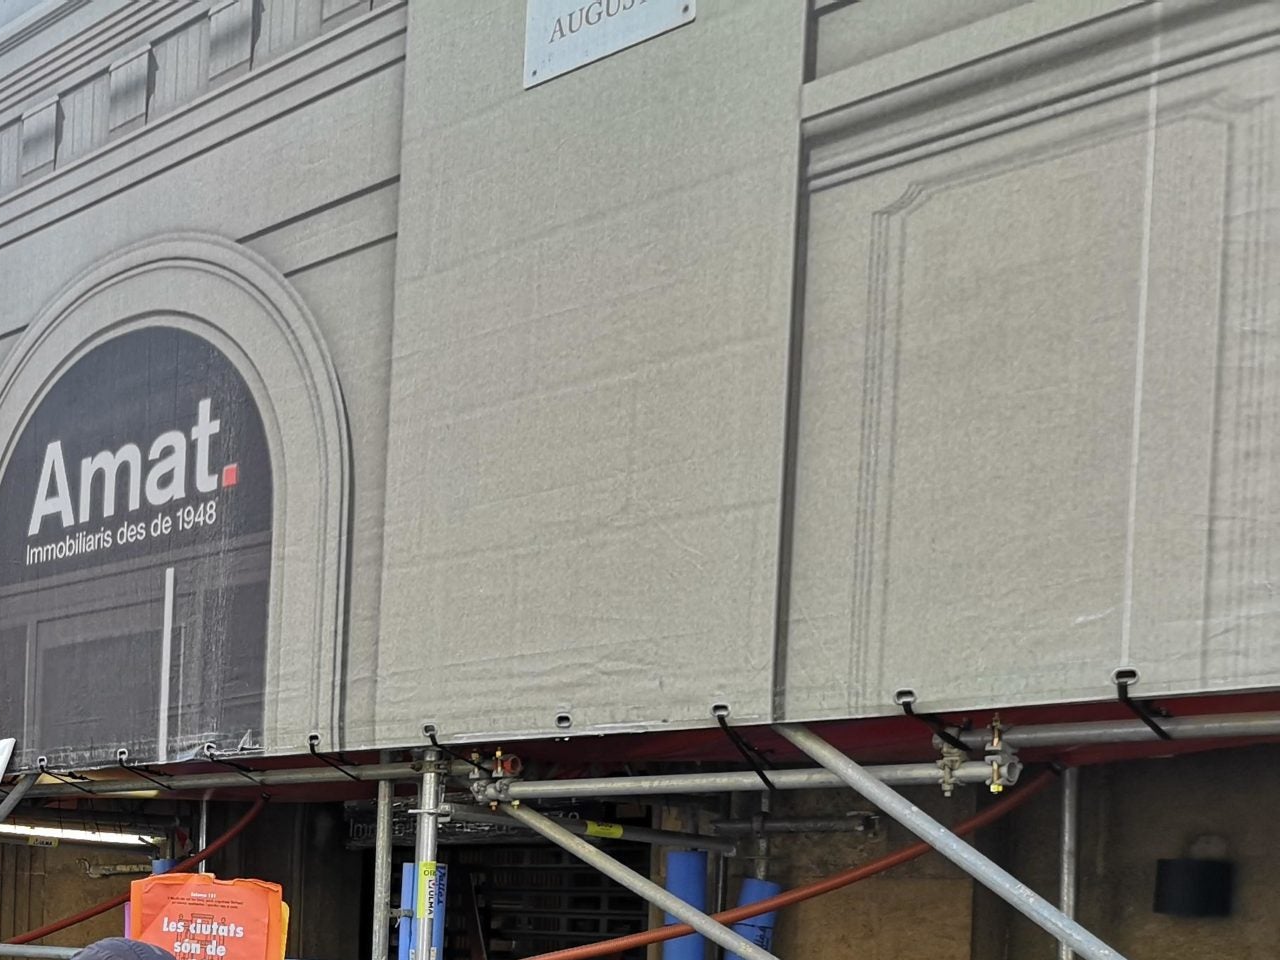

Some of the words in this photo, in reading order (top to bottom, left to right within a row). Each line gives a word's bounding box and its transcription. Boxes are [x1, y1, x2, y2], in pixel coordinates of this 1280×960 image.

[26, 527, 112, 566] Immobiliaris
[117, 521, 146, 545] des
[150, 513, 172, 537] de
[176, 500, 217, 531] 1948
[162, 917, 185, 932] Les
[189, 919, 244, 938] ciutats
[173, 939, 200, 955] són
[206, 940, 226, 956] de
